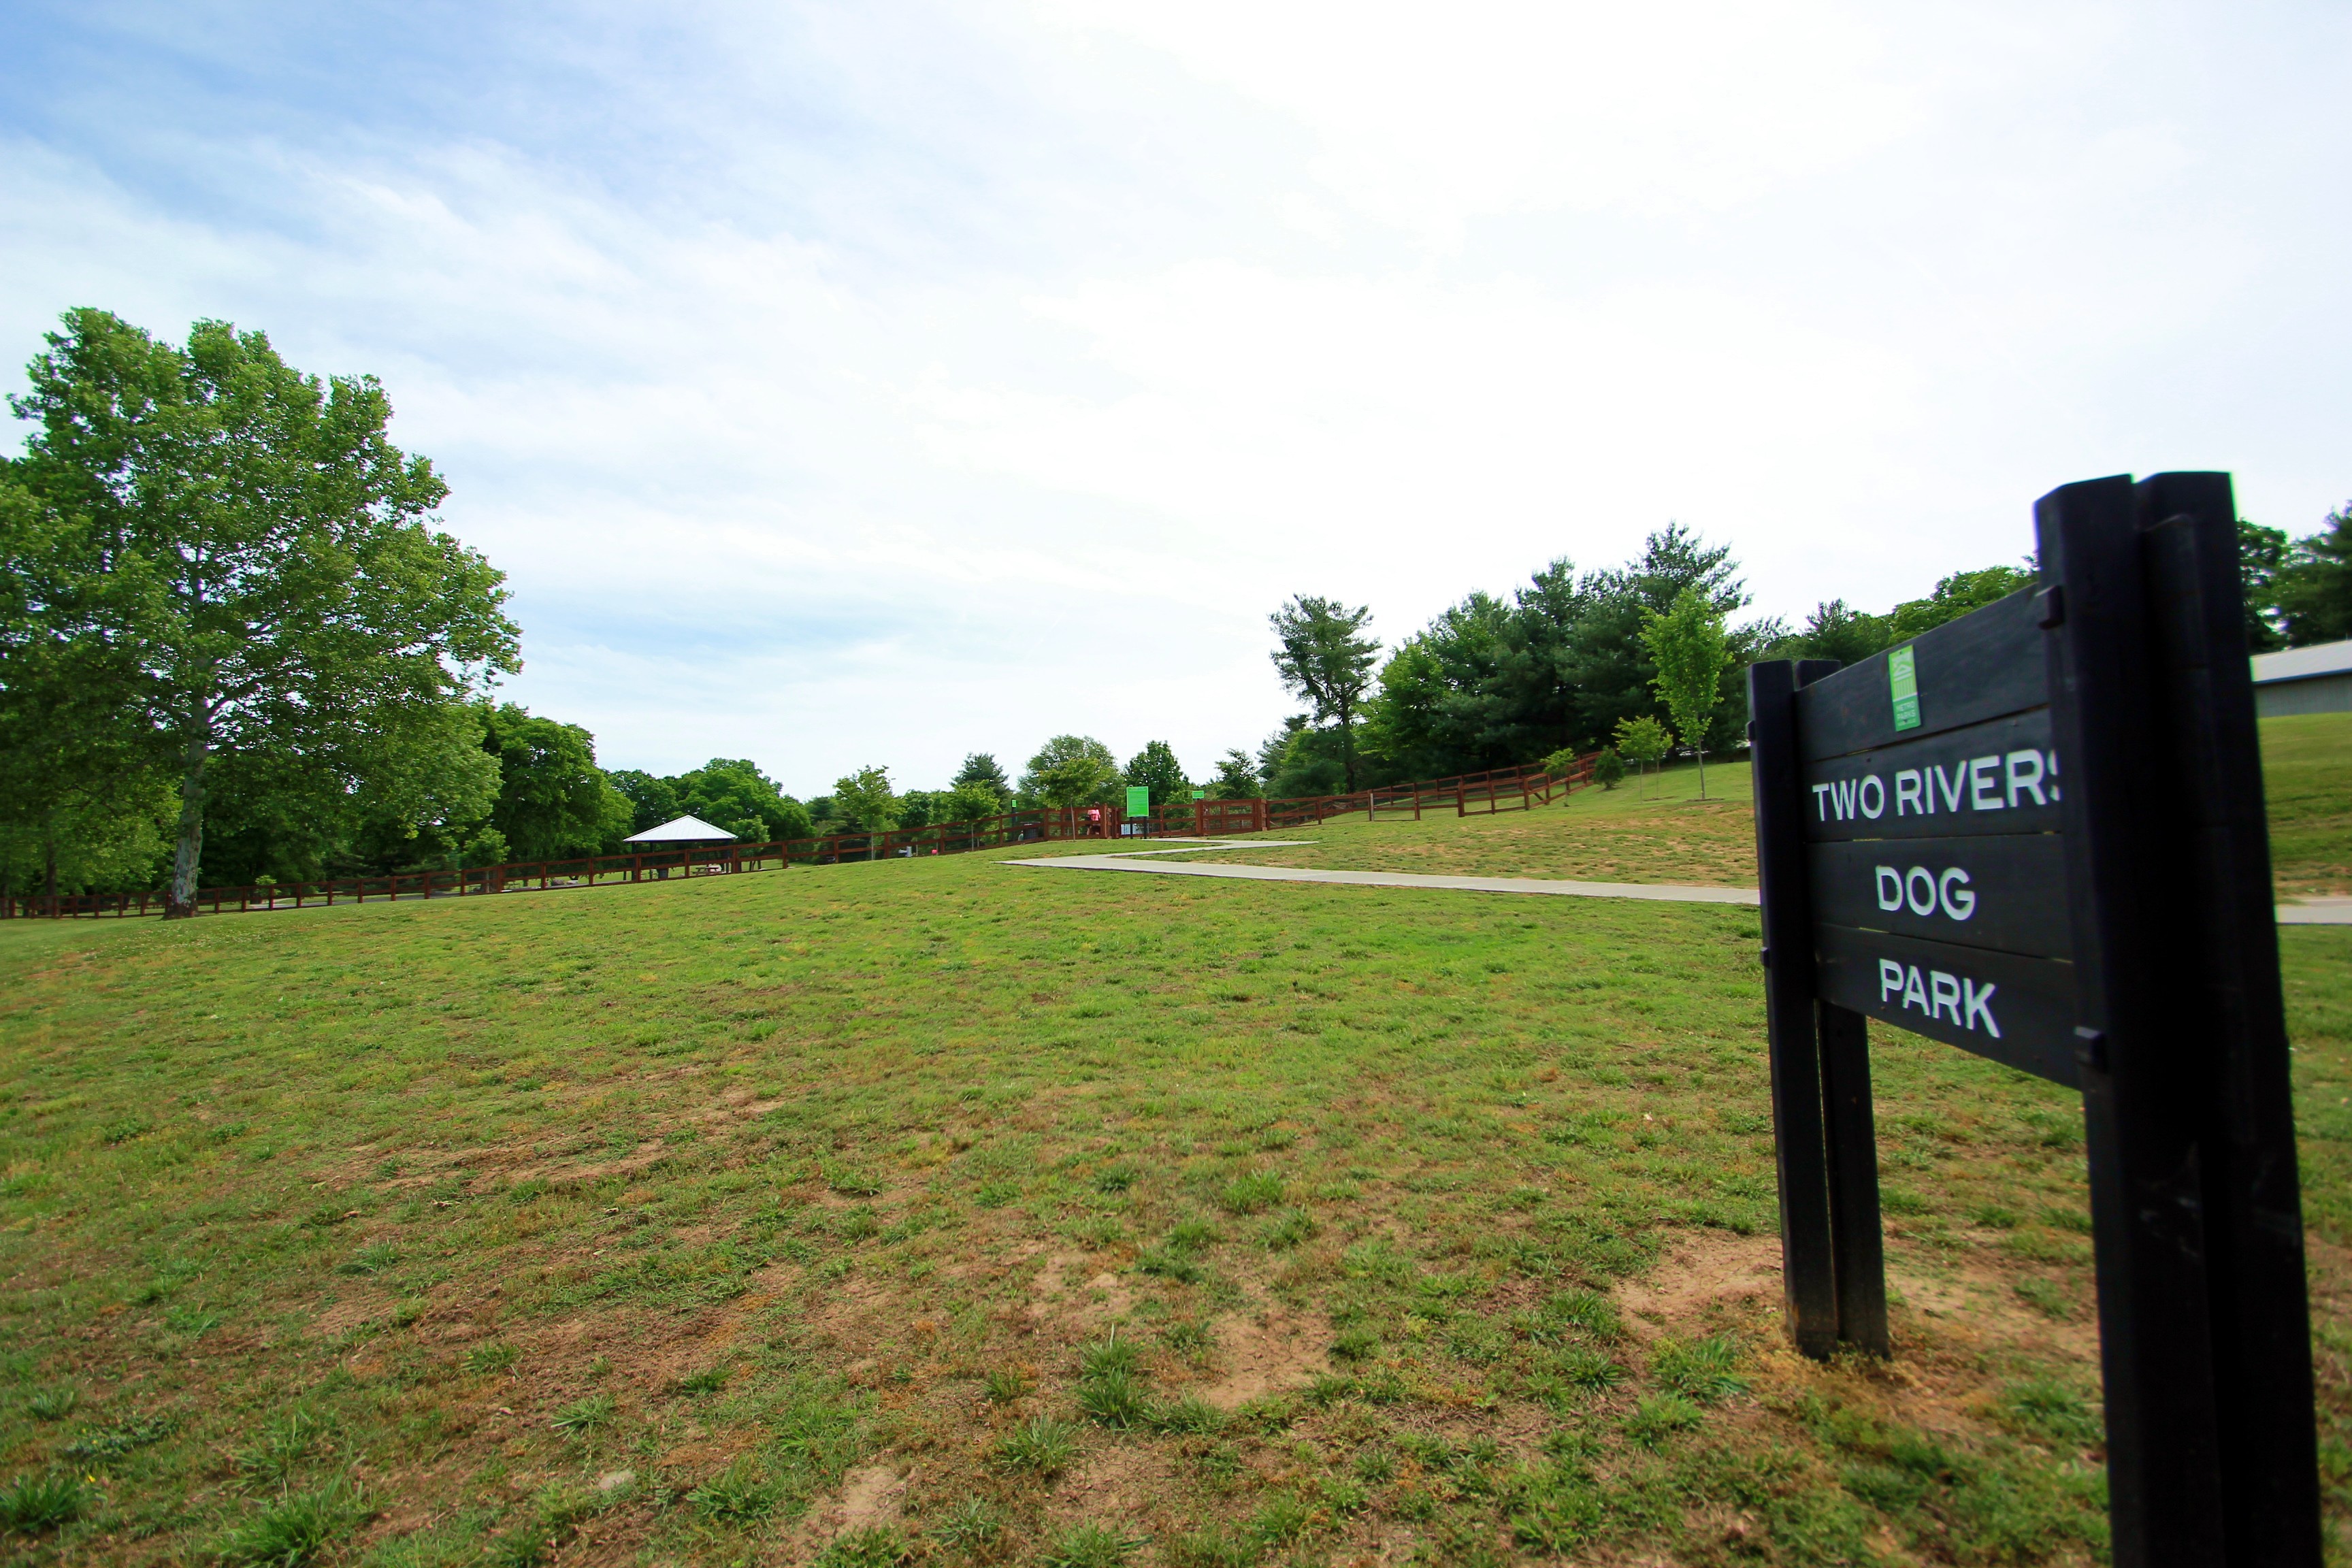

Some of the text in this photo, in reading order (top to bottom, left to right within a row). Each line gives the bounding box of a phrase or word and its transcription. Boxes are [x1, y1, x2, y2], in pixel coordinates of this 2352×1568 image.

[1812, 774, 1885, 821] TWO
[1876, 866, 1976, 921] DOG
[1880, 958, 2001, 1039] PARK
